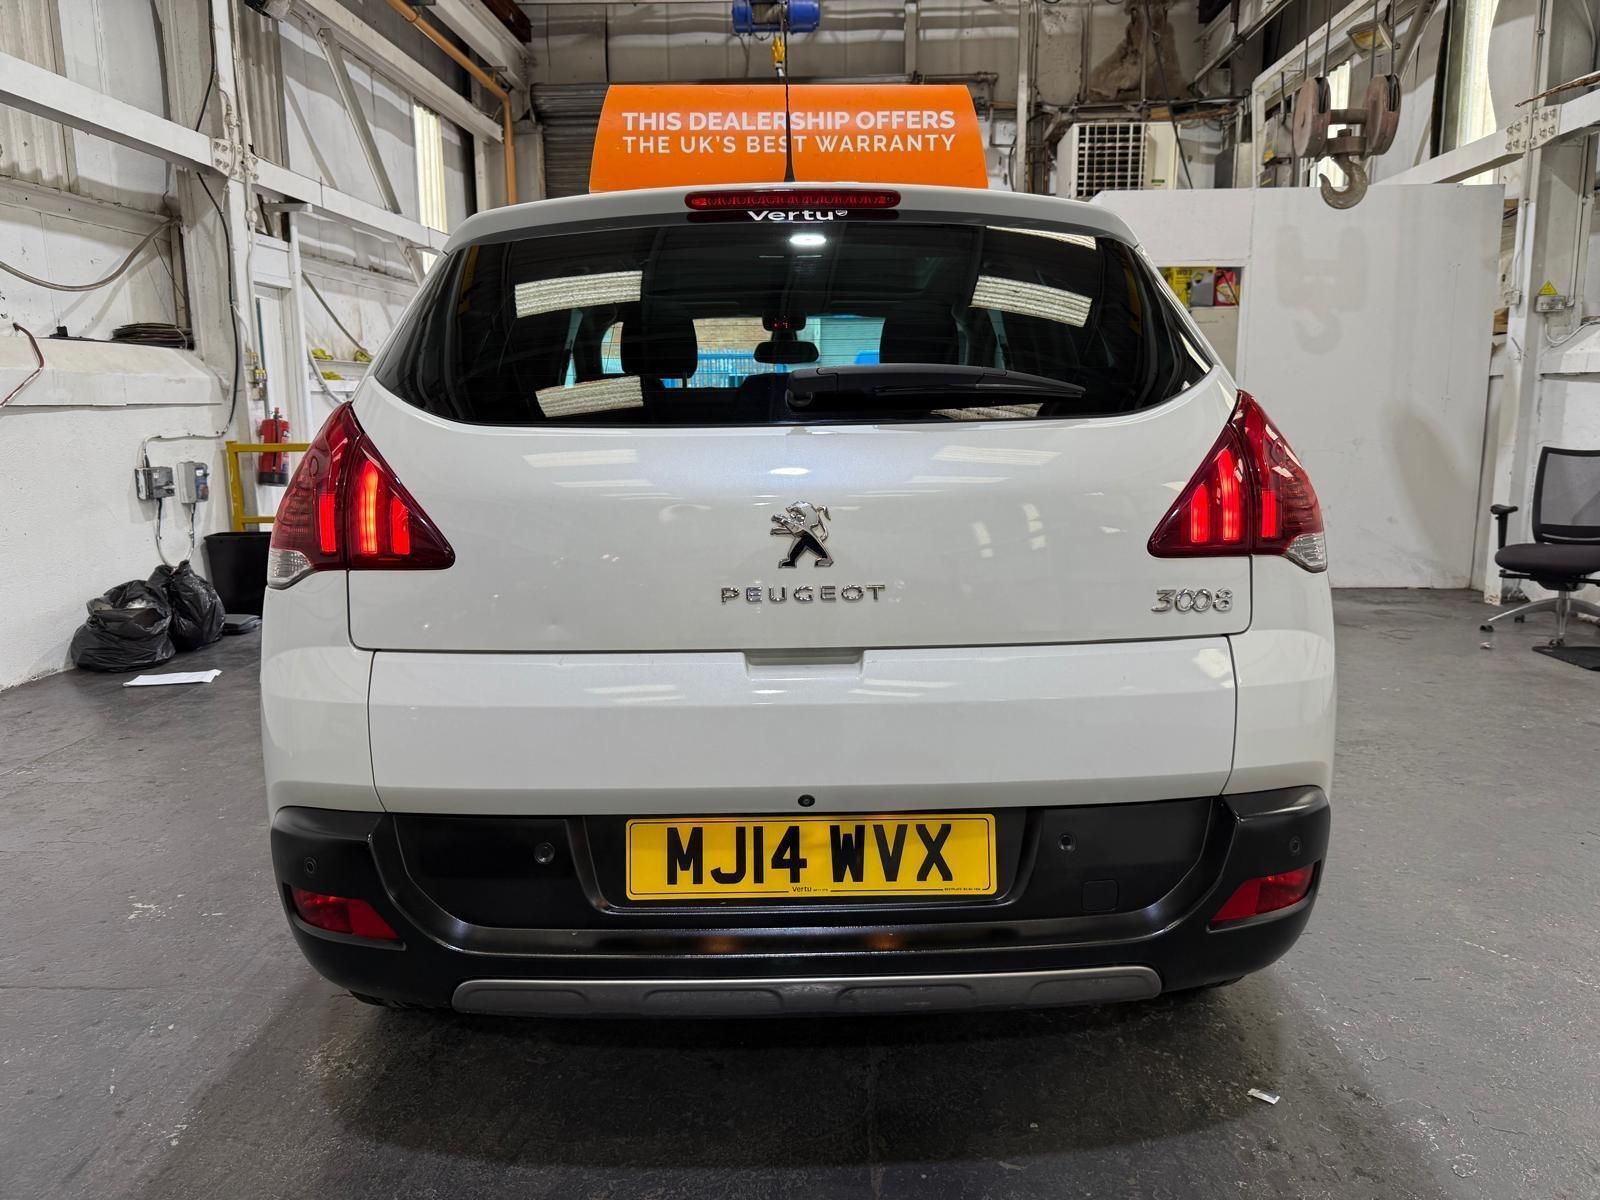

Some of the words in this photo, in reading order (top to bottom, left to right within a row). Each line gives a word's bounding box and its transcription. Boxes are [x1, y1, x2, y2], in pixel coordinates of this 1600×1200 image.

[621, 112, 682, 131] THIS
[689, 111, 850, 131] DEALERSHIP
[855, 110, 956, 130] OFFERS
[622, 136, 671, 154] THE
[680, 136, 736, 153] UK'S
[746, 135, 807, 153] BEST
[815, 134, 956, 153] WARRANTY
[747, 209, 834, 221] Vertu
[720, 584, 886, 604] PEUGEOT
[1151, 588, 1233, 613] 3008
[666, 825, 808, 885] MJ14
[829, 823, 953, 883] WVX
